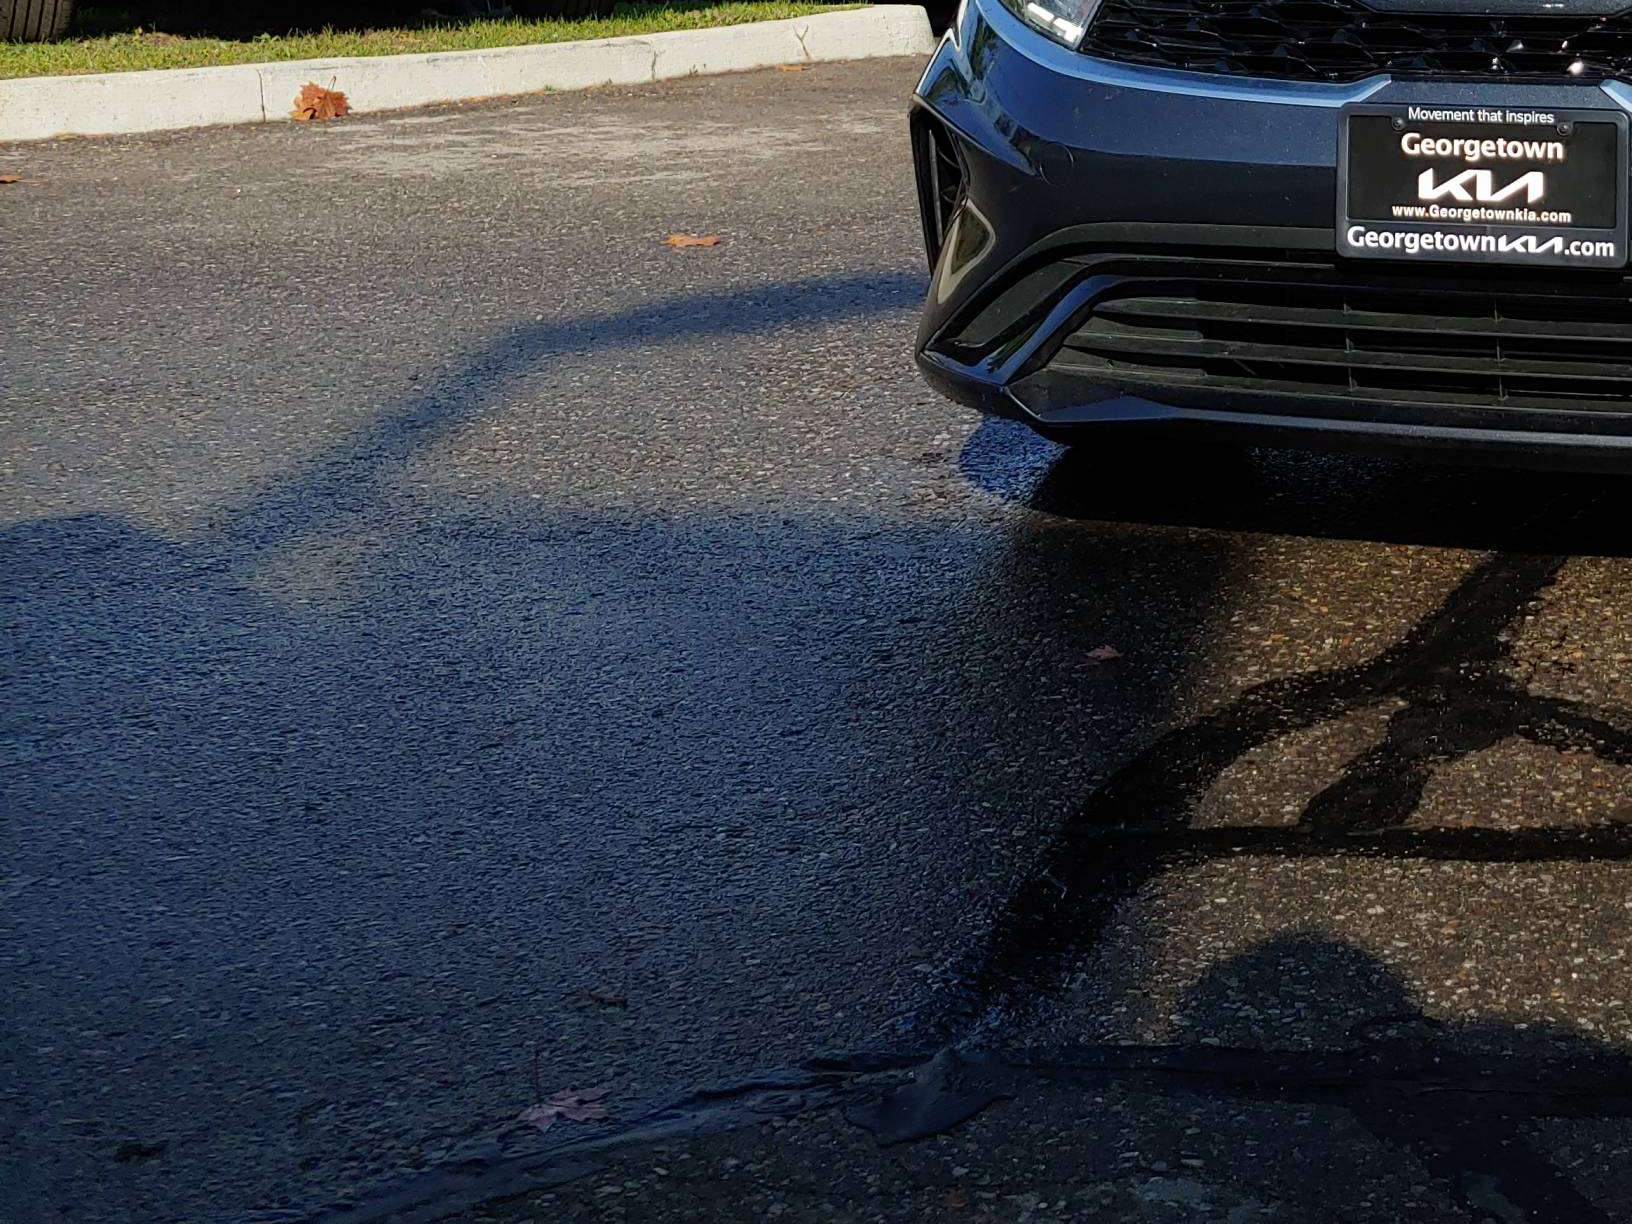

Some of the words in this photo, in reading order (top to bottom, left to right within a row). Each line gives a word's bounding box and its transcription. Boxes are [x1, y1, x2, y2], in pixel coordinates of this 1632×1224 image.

[1407, 107, 1475, 122] Movement
[1477, 108, 1502, 123] that
[1505, 110, 1555, 126] inspires
[1400, 132, 1565, 162] Georgetown
[1417, 167, 1545, 205] KIA
[1391, 204, 1573, 224] www.Georgetownkia.com
